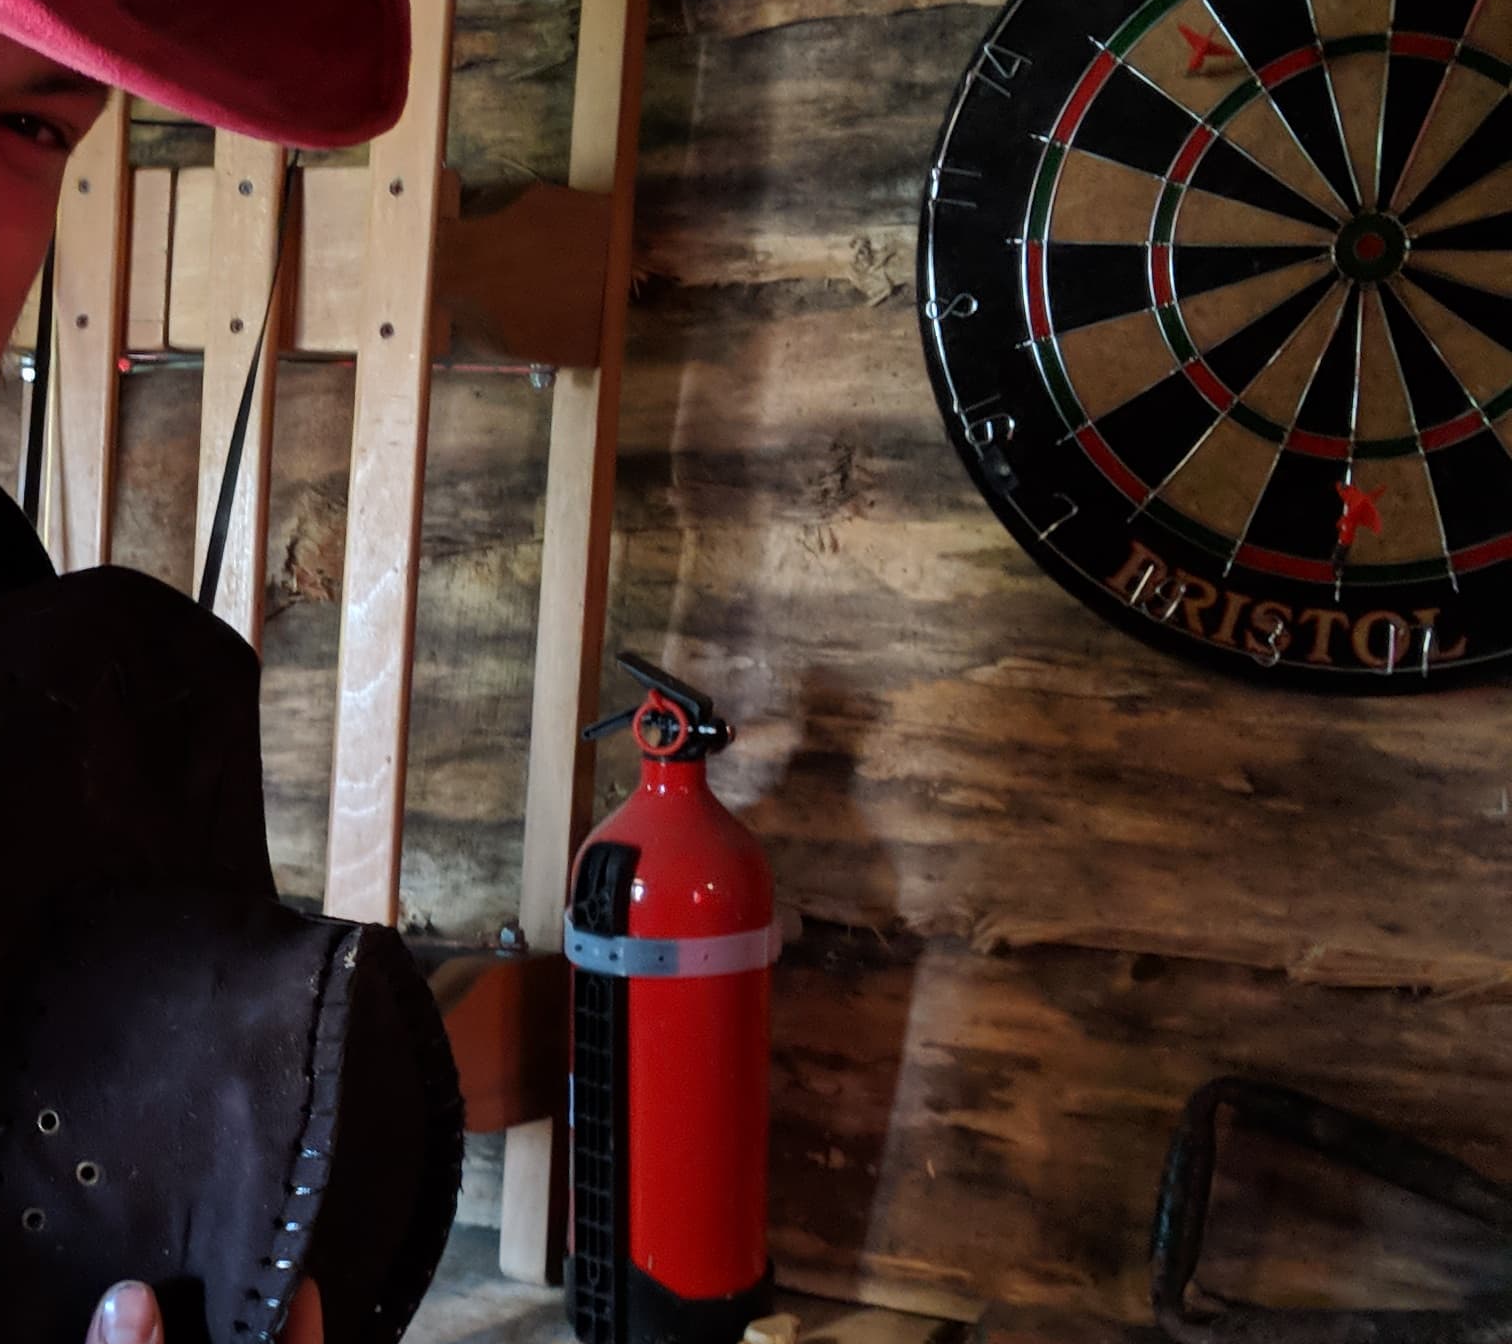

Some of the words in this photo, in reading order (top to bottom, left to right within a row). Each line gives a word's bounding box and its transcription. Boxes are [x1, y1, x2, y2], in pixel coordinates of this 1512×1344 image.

[968, 41, 1034, 100] 14
[924, 291, 980, 323] 8
[1103, 537, 1471, 669] BRISTOL
